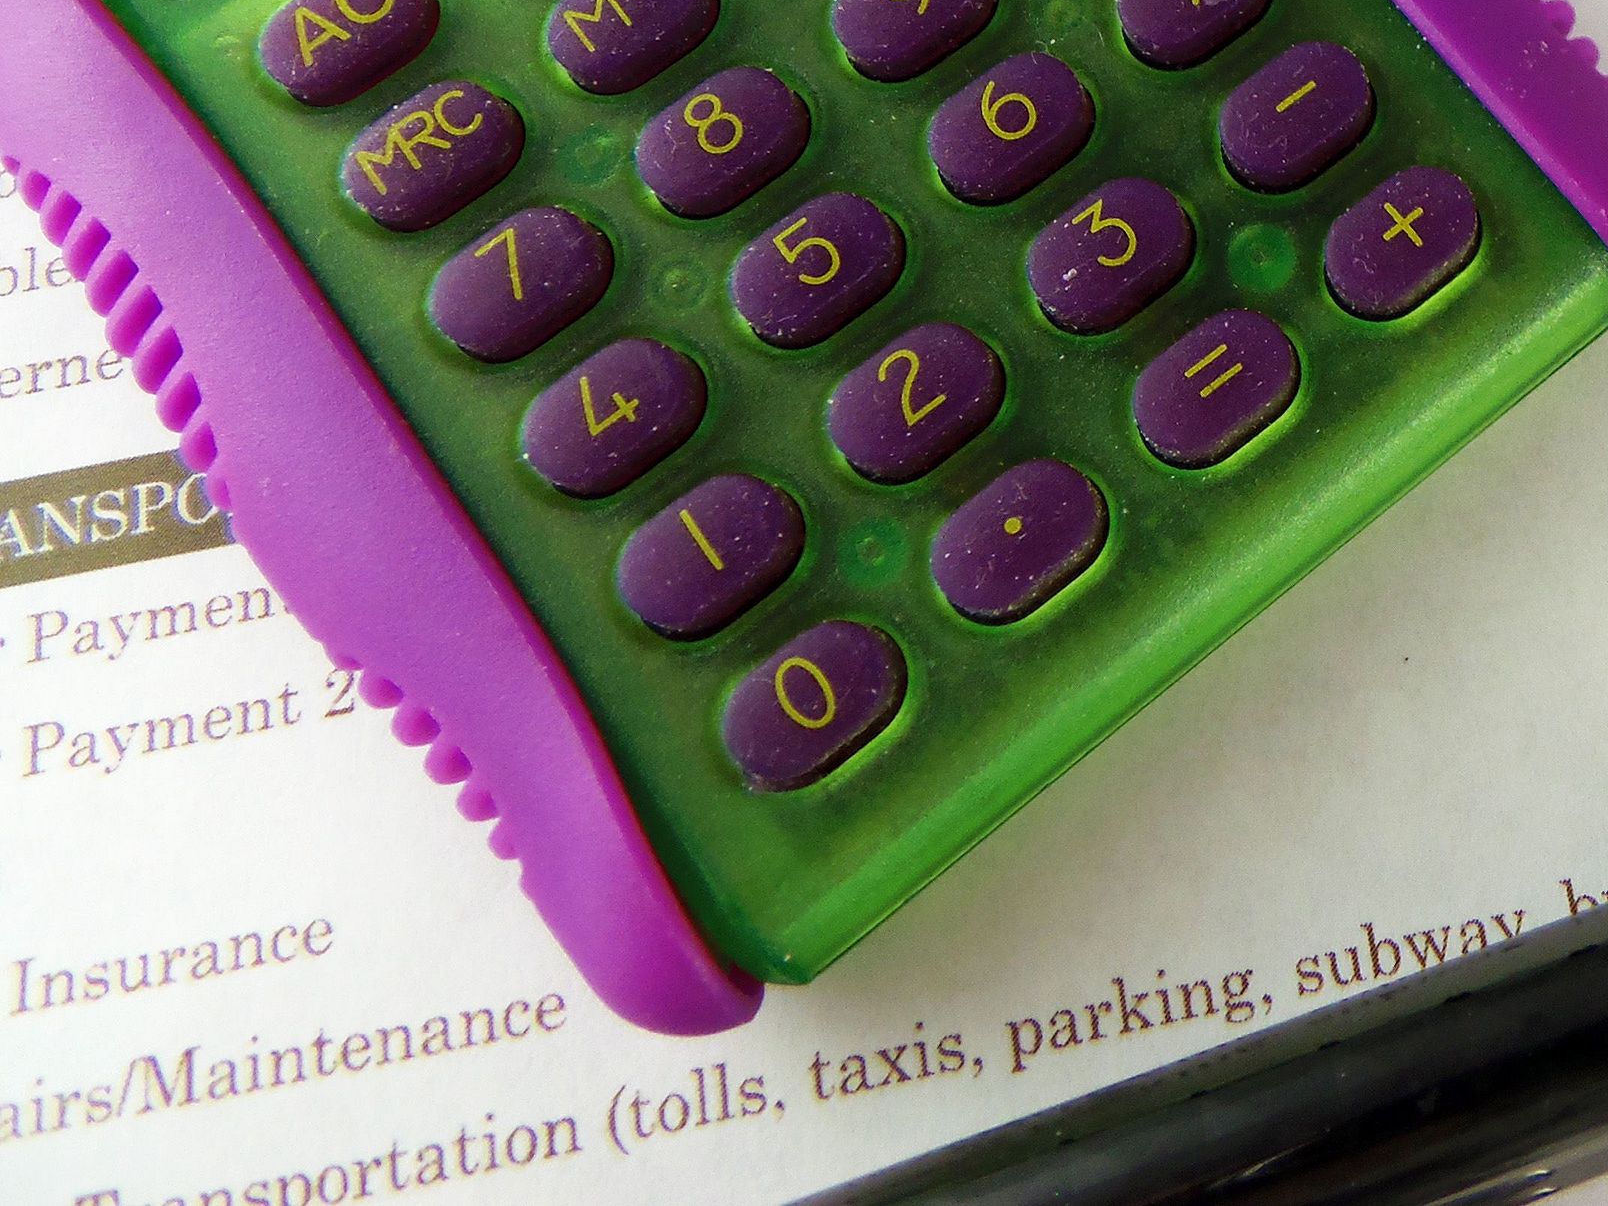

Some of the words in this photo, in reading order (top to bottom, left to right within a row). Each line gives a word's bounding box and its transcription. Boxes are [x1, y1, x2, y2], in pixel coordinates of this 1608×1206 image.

[355, 89, 484, 196] MRC
[683, 92, 744, 154] 8
[980, 79, 1038, 141] 6
[473, 227, 524, 301] 7
[772, 216, 841, 285] 5
[1071, 198, 1138, 268] 3
[578, 375, 640, 438] 4
[877, 348, 948, 427] 2
[679, 508, 725, 572] 1
[26, 586, 291, 664] Paymen
[23, 682, 302, 777] Payment
[323, 668, 357, 718] 2
[773, 656, 837, 730] 0
[9, 917, 334, 1017] Insurance
[607, 1062, 785, 1154] (tolls,
[810, 1020, 984, 1105] taxis,
[1007, 964, 1274, 1075] parking,
